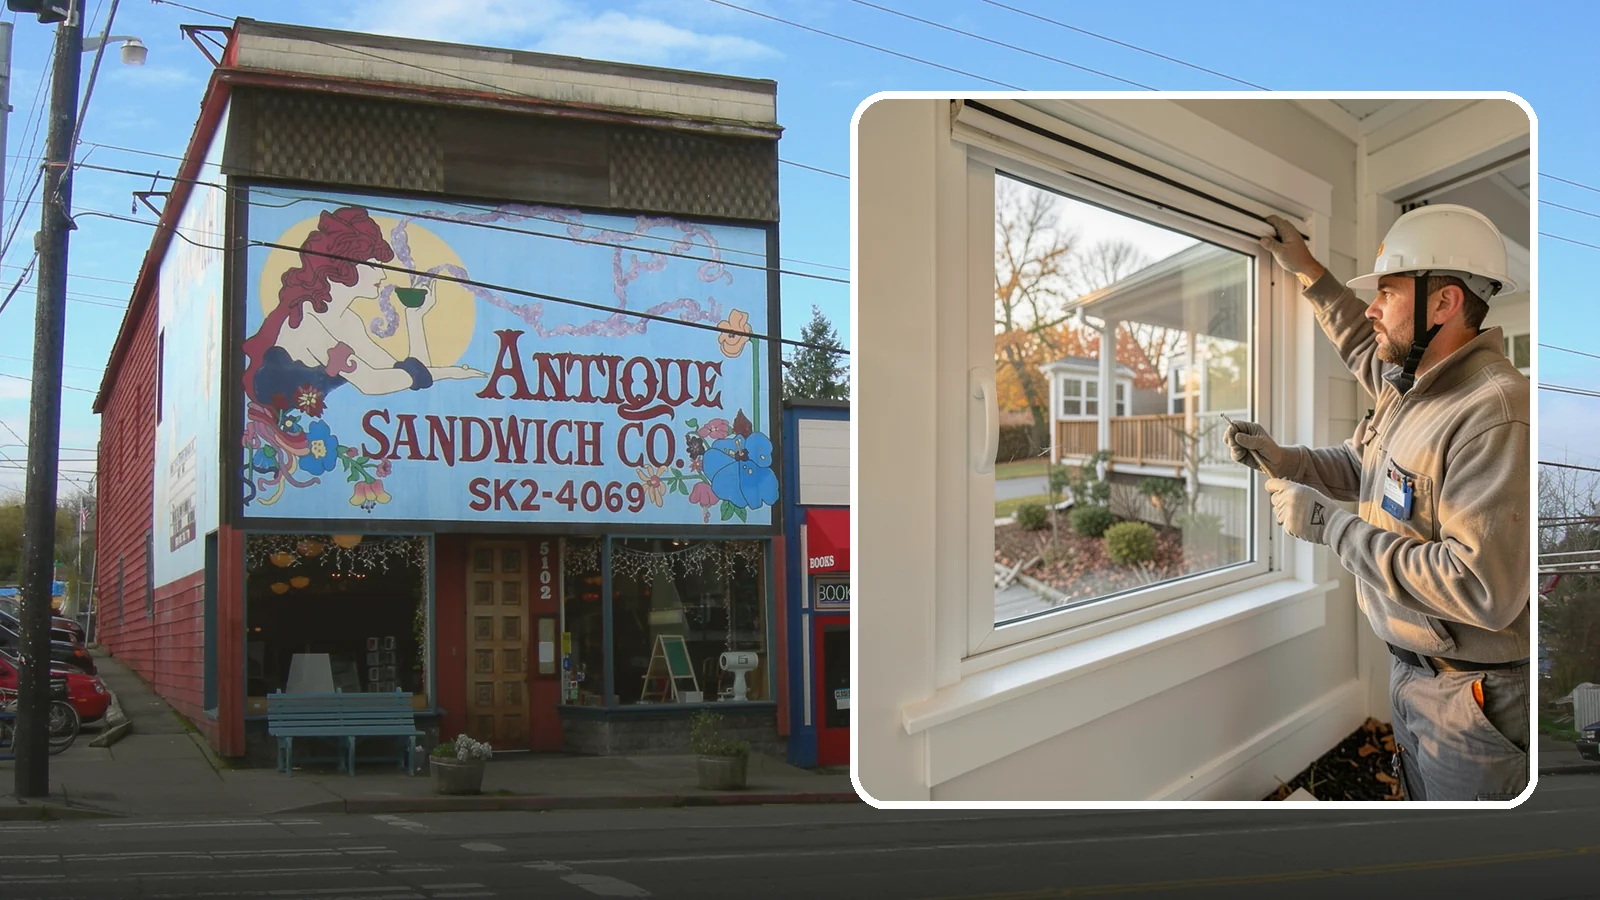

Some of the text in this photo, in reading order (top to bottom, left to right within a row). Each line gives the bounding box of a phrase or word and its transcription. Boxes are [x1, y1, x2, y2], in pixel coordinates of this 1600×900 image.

[476, 329, 723, 420] ANTIQUE
[361, 409, 685, 468] SANDWICH CO.
[468, 477, 646, 513] SK2-4069
[539, 541, 552, 600] 5102
[809, 555, 835, 569] BOOKS
